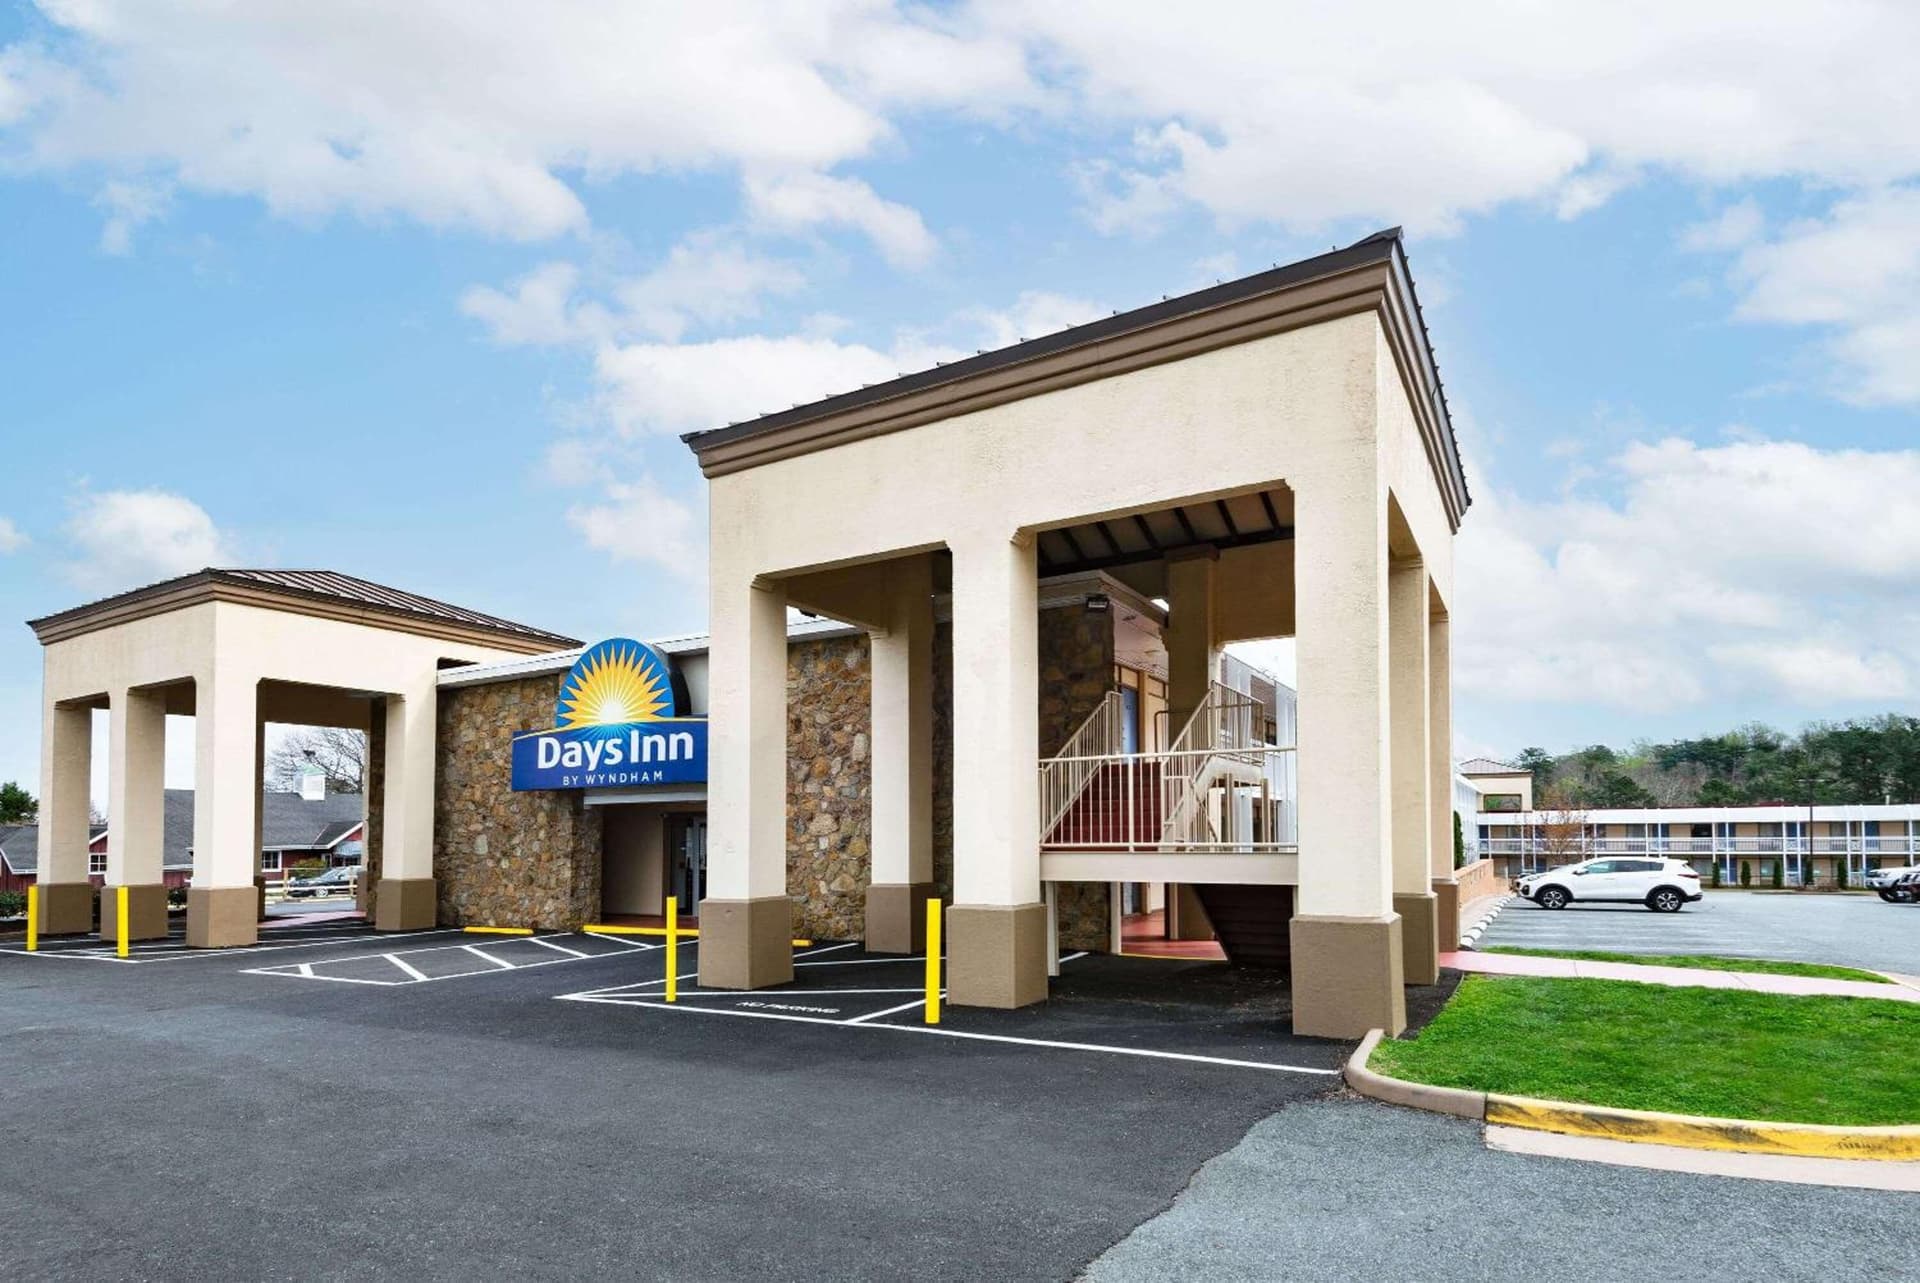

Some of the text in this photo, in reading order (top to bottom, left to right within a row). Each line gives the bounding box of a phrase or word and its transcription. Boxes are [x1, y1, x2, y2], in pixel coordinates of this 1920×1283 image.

[537, 729, 694, 771] Days Inn
[562, 770, 663, 786] BY WYNDHAM
